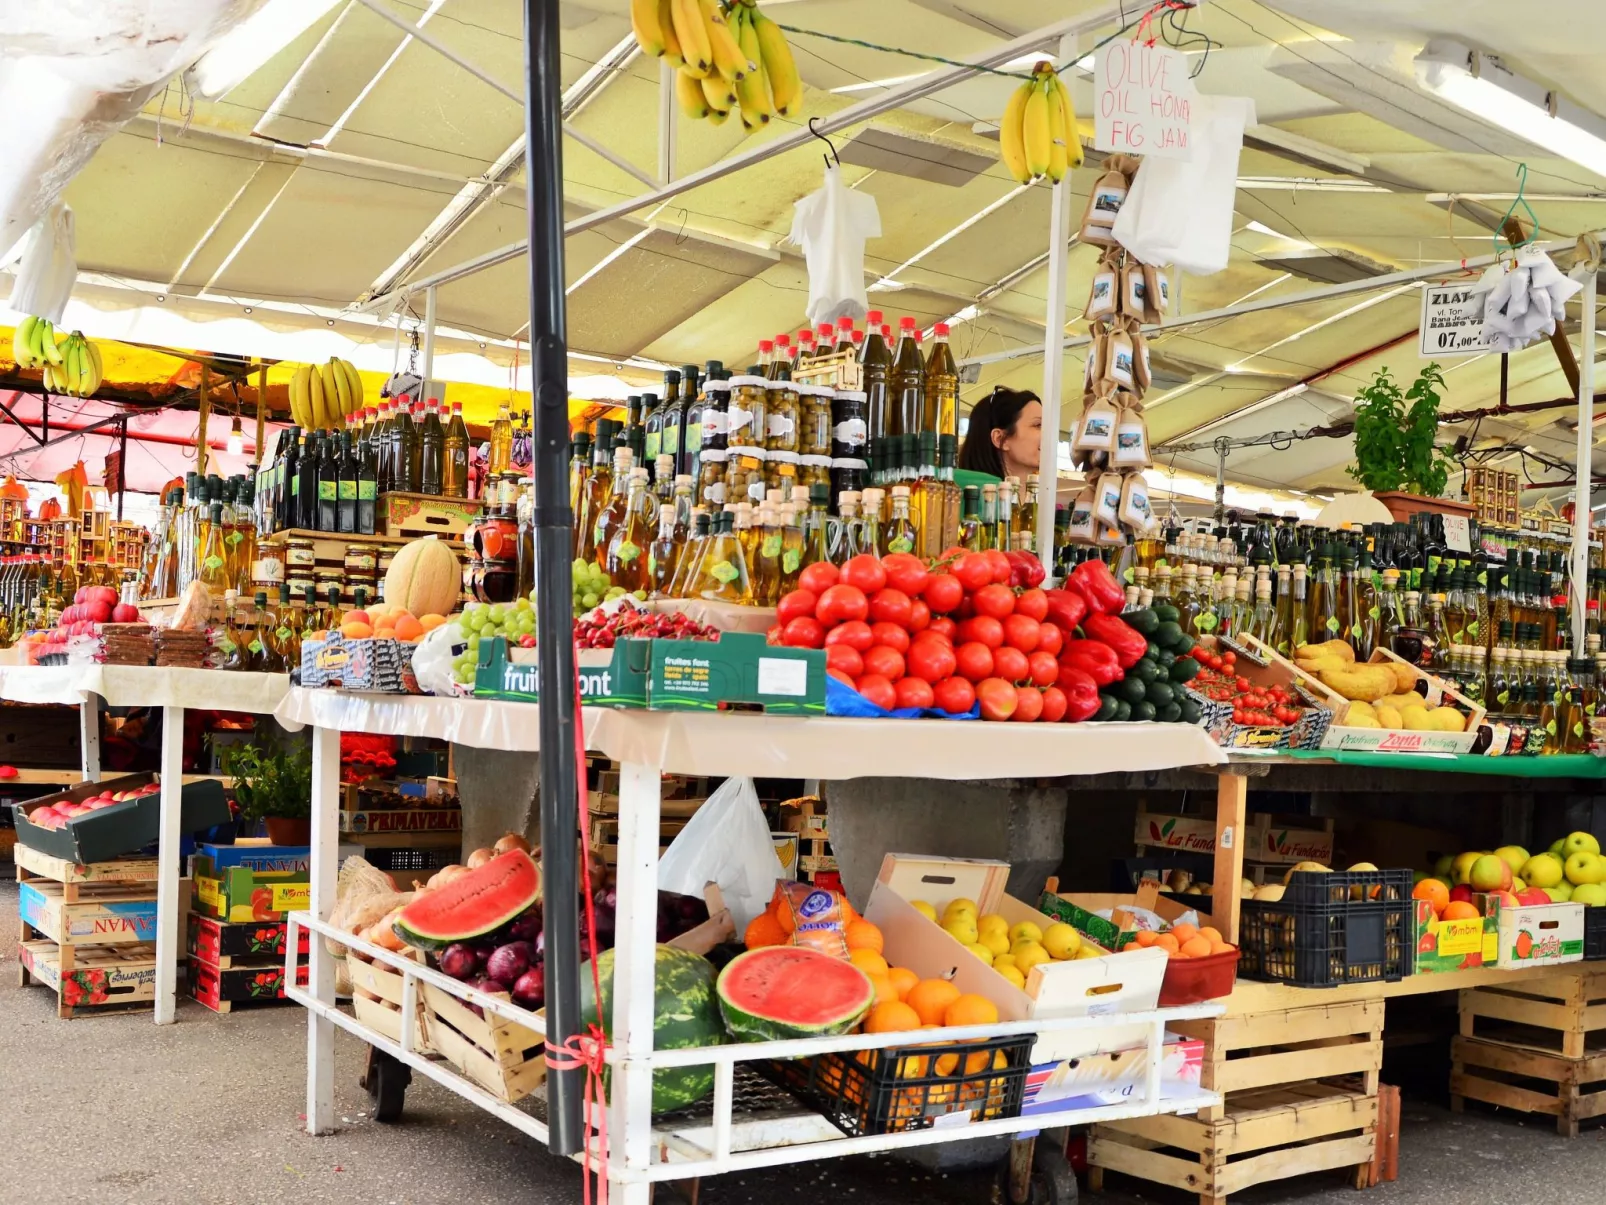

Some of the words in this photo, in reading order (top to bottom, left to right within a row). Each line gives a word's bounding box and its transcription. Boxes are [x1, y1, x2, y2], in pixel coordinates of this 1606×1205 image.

[1106, 44, 1172, 92] OLIVE
[1101, 90, 1138, 118] OIL
[1111, 120, 1144, 147] FIG
[1153, 128, 1187, 148] JAM
[504, 665, 540, 693] fruit
[577, 670, 612, 696] ont
[1378, 733, 1422, 750] Zonta
[368, 812, 460, 831] PRIMAVERA
[1167, 830, 1184, 846] La
[1184, 833, 1216, 852] Fund
